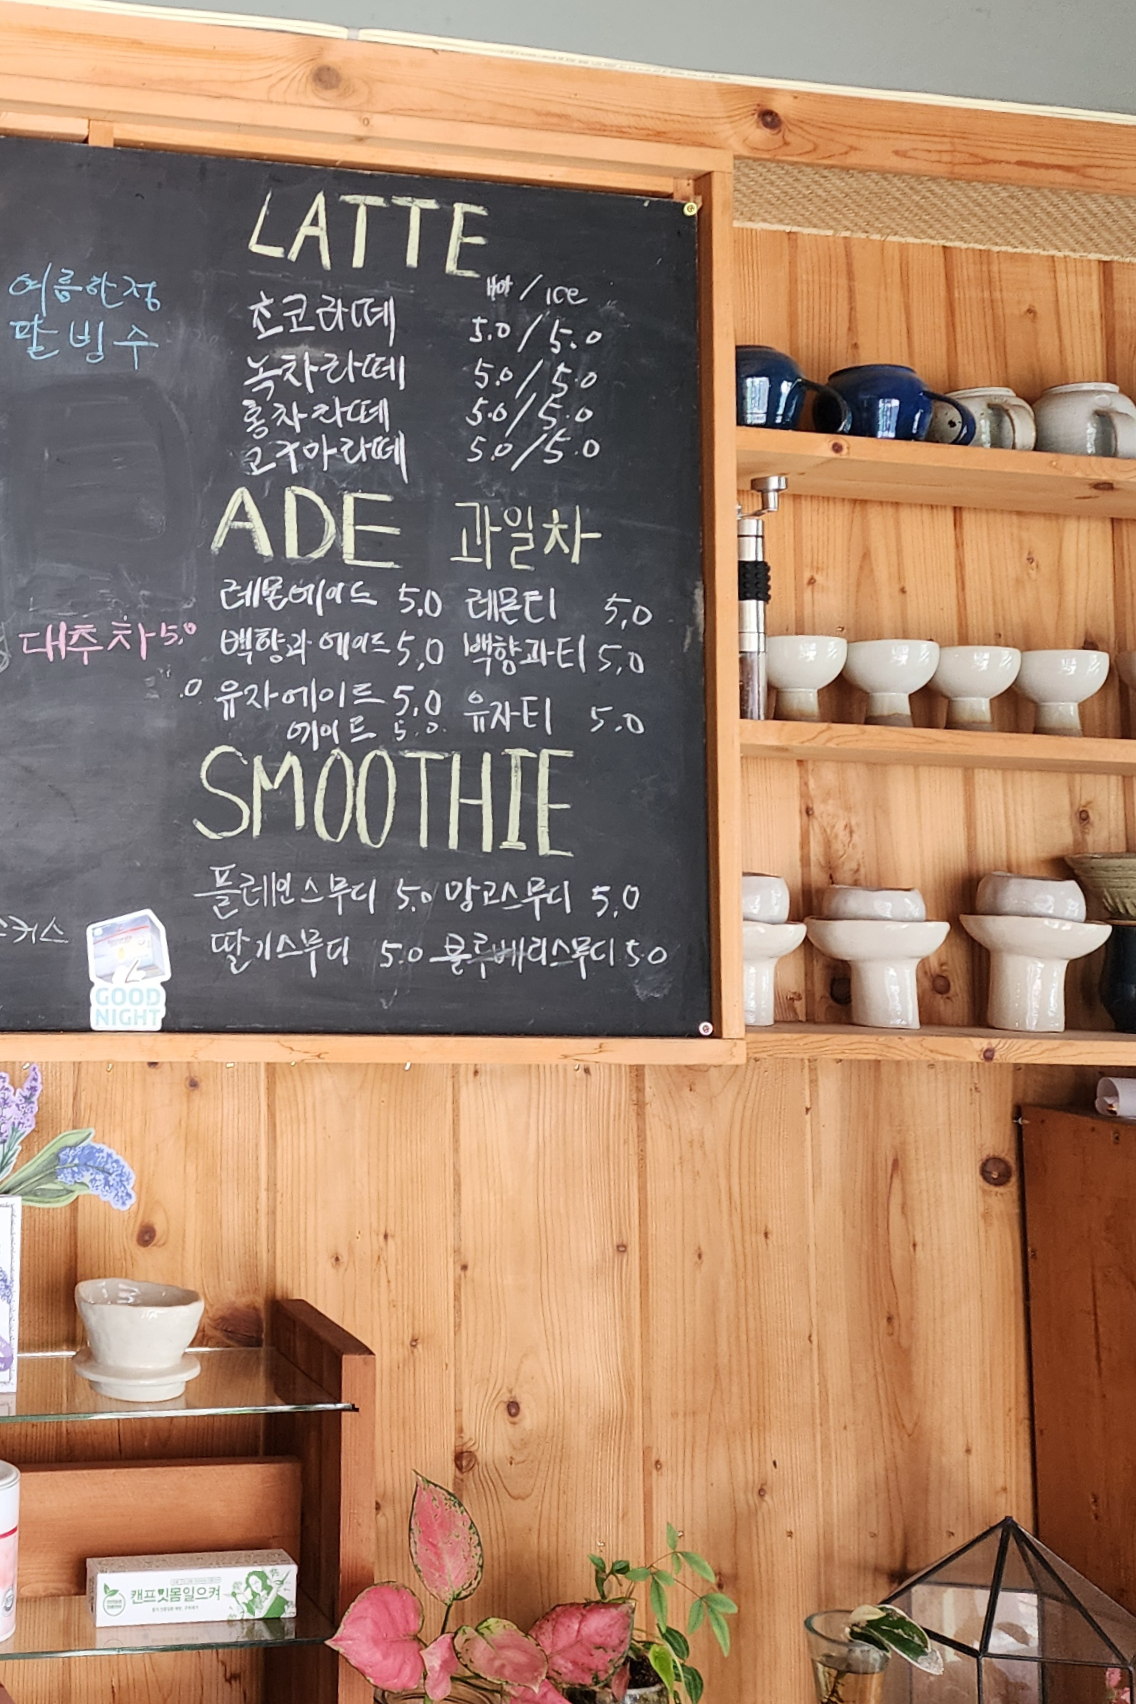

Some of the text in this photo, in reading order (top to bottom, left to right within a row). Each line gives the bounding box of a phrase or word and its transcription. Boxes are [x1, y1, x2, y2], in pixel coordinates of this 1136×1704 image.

[248, 190, 489, 278] LATTE
[248, 290, 396, 346] 초코라떼
[243, 351, 405, 402] 녹차라떼
[210, 485, 402, 569] ADE
[450, 503, 602, 571] 과일차
[465, 587, 555, 624] 레몬티
[18, 621, 156, 665] 대추차
[463, 690, 552, 735] 유자티
[193, 744, 574, 856] SMOOTHIE
[95, 987, 161, 1006] GOOD
[95, 1008, 160, 1026] NIGHT
